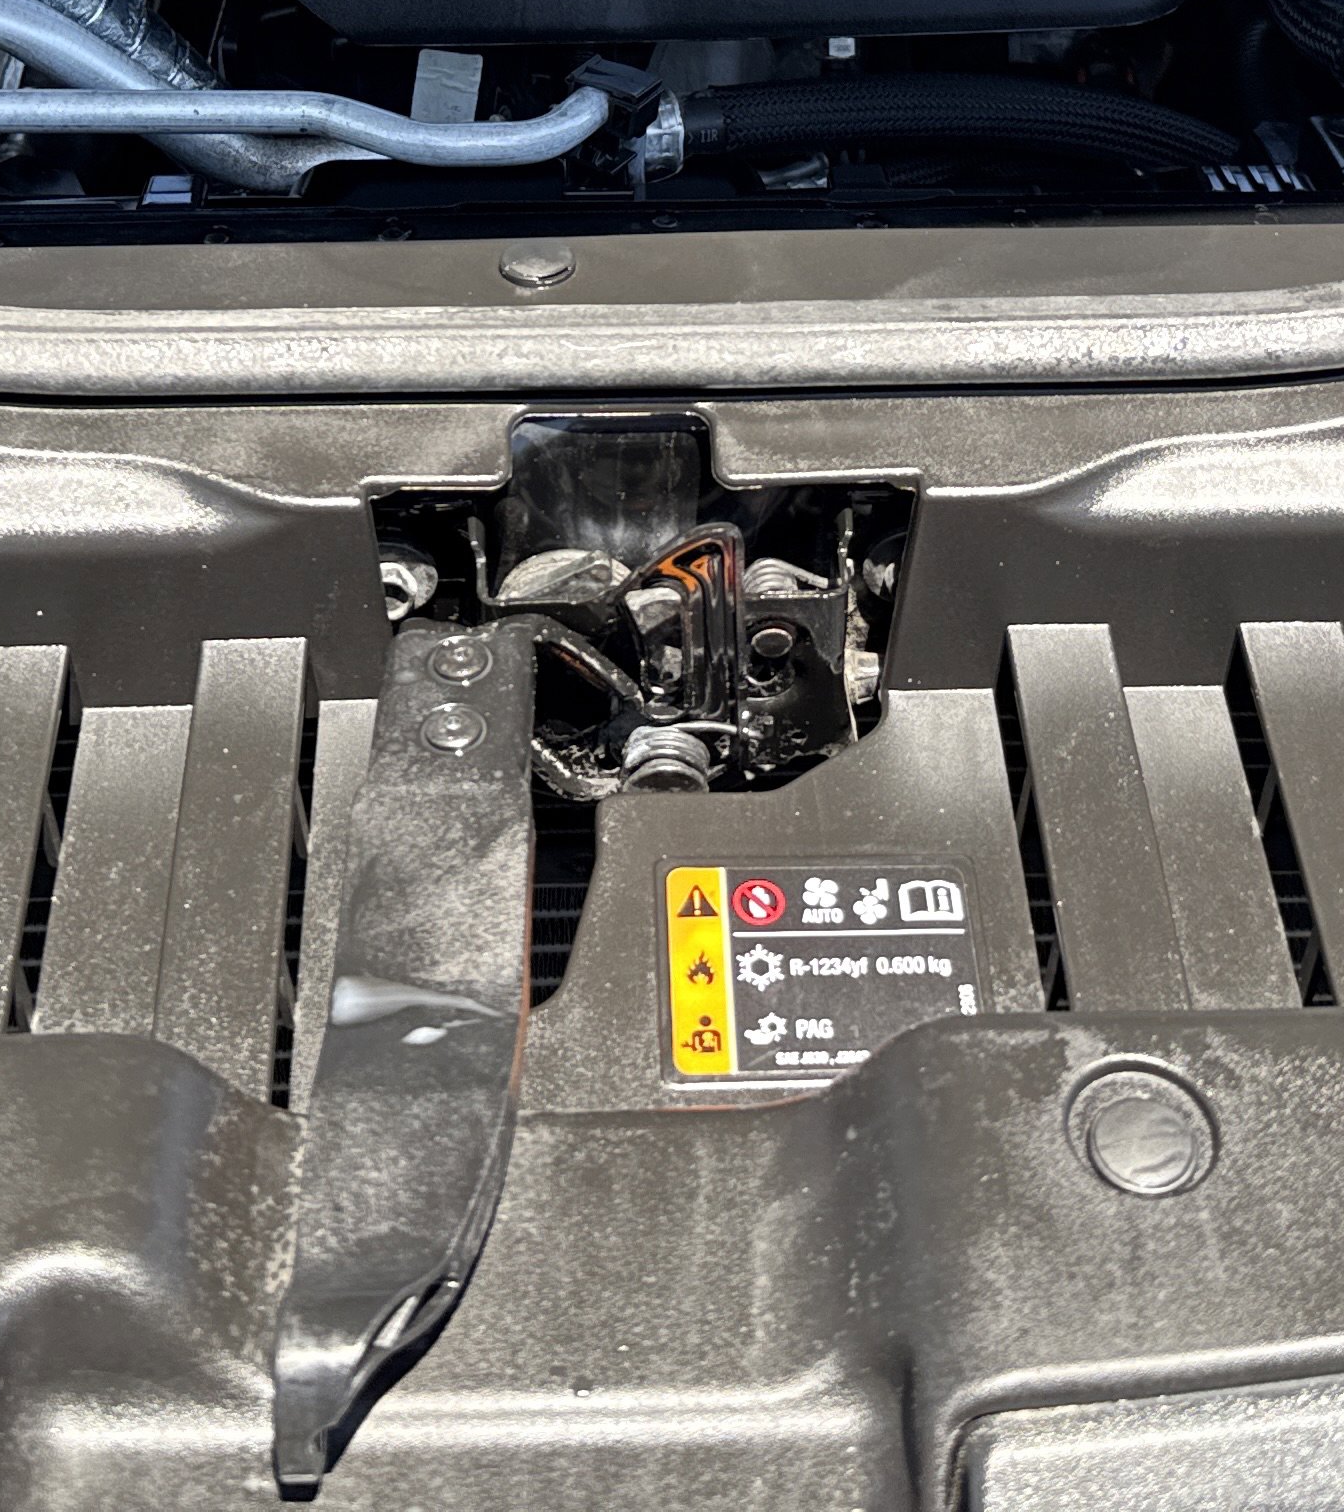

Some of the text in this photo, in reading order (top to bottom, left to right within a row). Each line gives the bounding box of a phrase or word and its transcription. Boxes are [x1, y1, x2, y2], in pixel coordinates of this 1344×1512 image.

[801, 907, 845, 924] AUTO
[789, 956, 869, 979] R-1234yf
[927, 955, 953, 978] kg
[795, 1018, 835, 1040] PAG
